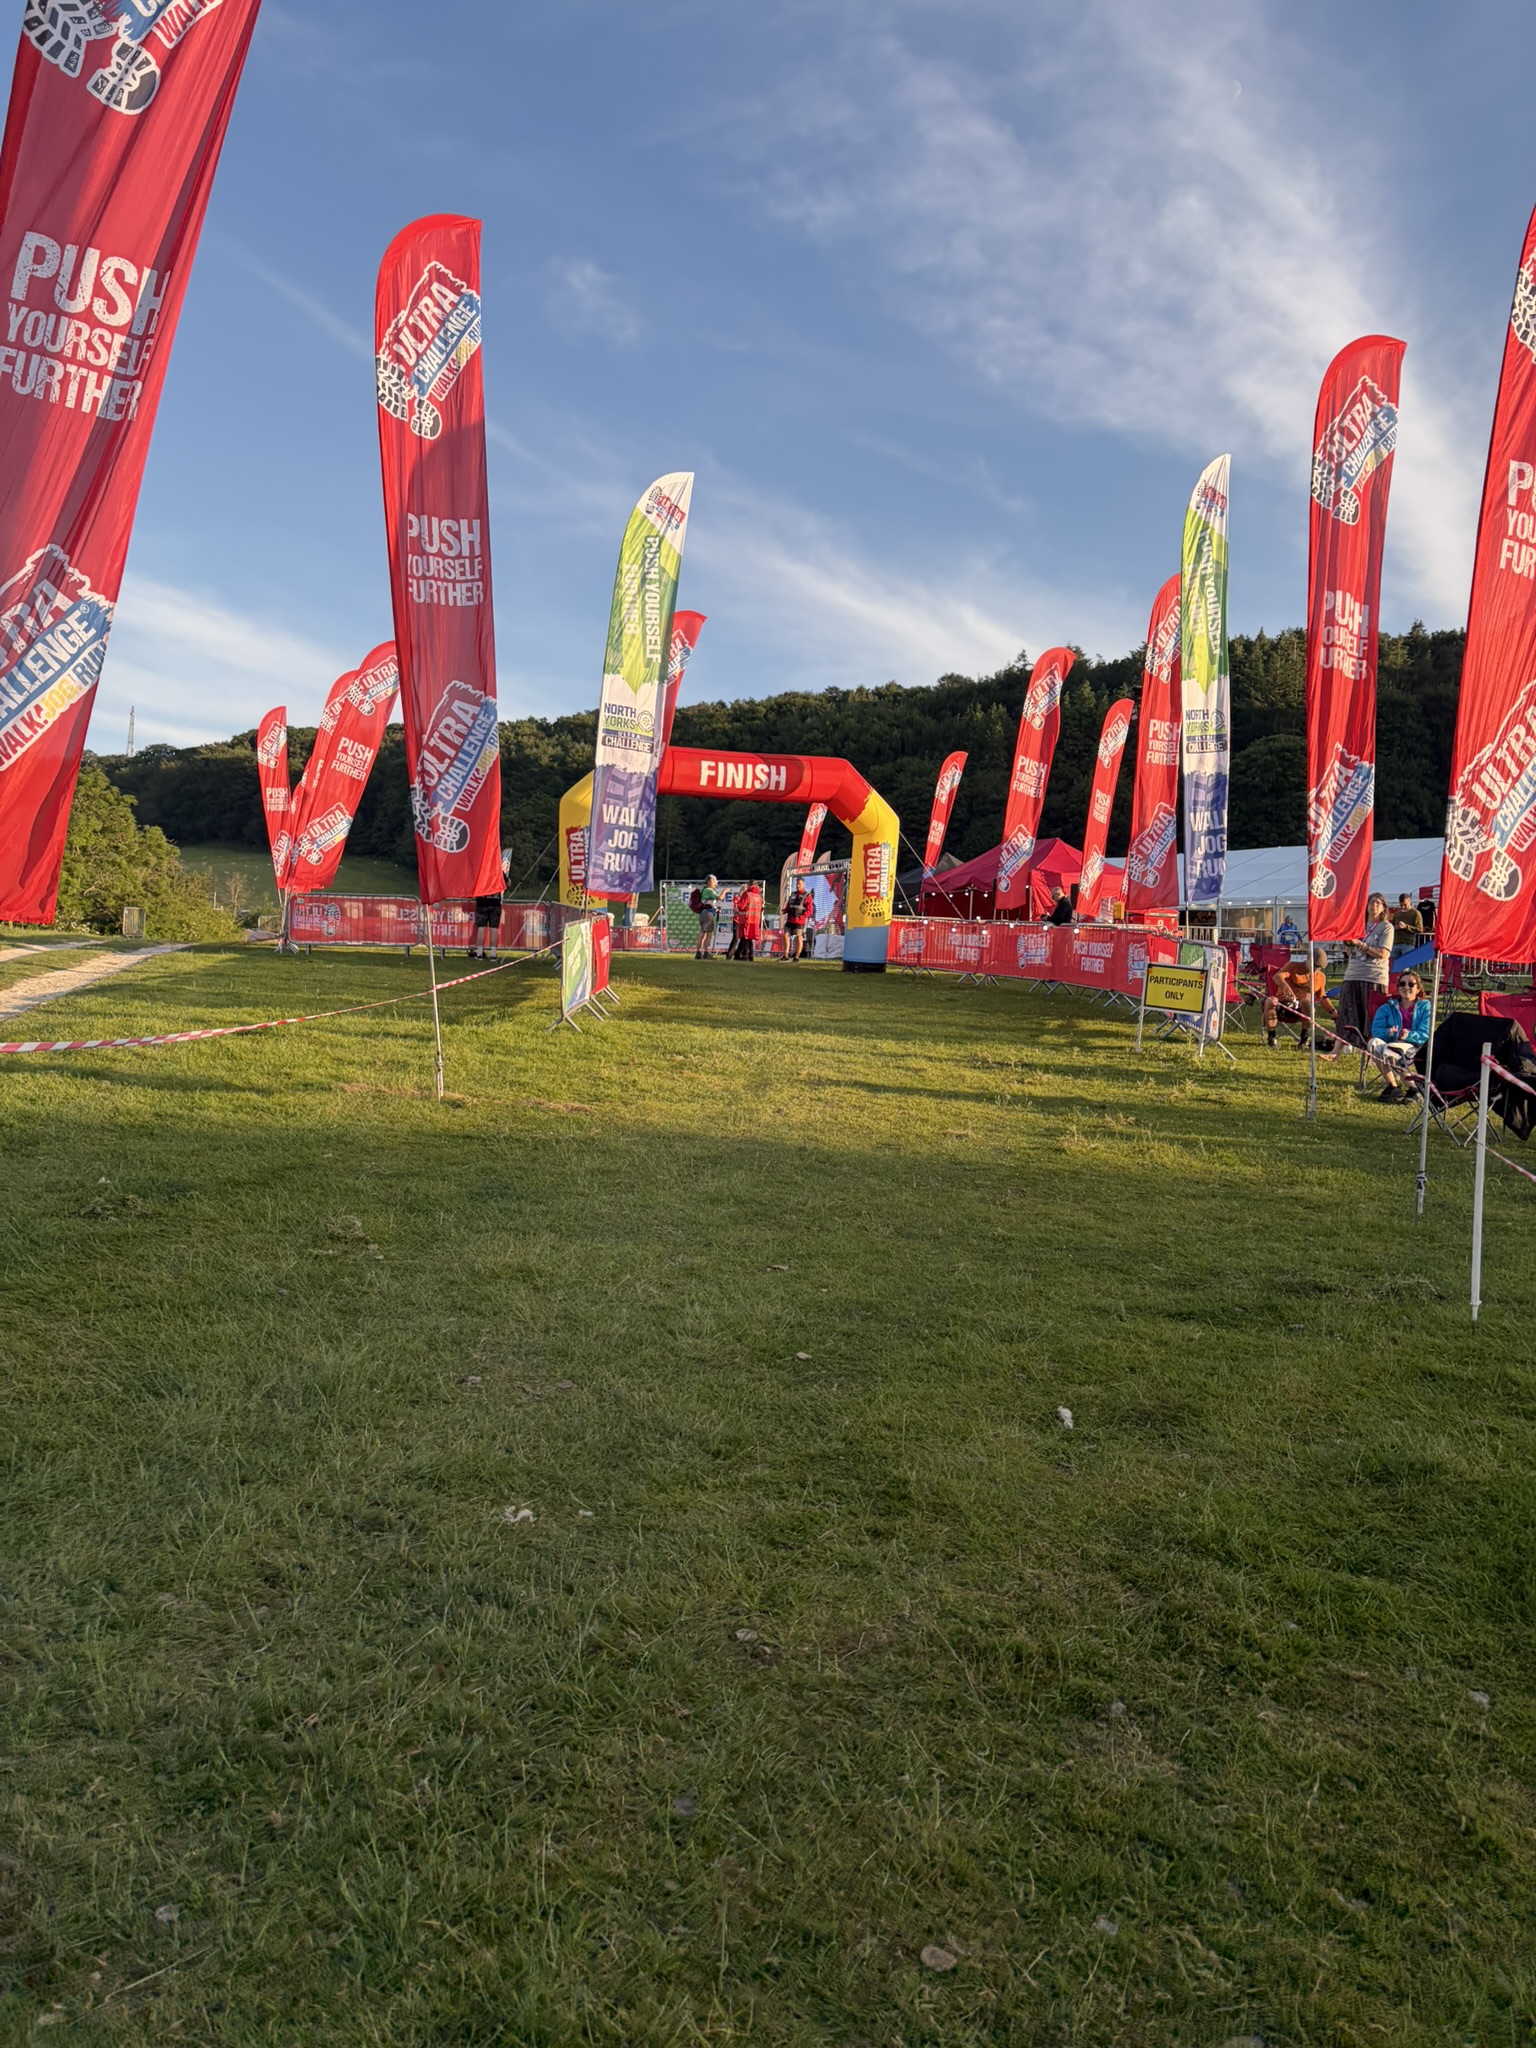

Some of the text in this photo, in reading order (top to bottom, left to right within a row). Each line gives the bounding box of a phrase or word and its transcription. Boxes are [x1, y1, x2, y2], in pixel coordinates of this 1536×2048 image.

[11, 231, 170, 335] PUSH
[392, 281, 460, 366] ULTRA
[6, 302, 153, 378] YOURSELF
[414, 300, 476, 384] CHALLENGE
[0, 345, 143, 421] FURTHER
[407, 512, 480, 557] PUSH
[645, 536, 661, 663] PUSH YOURSELF
[1325, 590, 1369, 637] PUH
[1323, 626, 1368, 657] OURELF
[0, 608, 97, 722] ALLENGE
[363, 661, 398, 689] ULTRA
[603, 714, 636, 730] YORKS
[604, 702, 637, 719] NORTH
[423, 699, 481, 787] ULTRA
[605, 735, 651, 753] CHALLENGE
[1149, 718, 1181, 741] PUSH
[335, 750, 369, 771] YOURSELF
[338, 736, 374, 763] PUSH
[436, 710, 494, 801] CHALLENGE
[330, 759, 366, 782] FURTHER
[700, 760, 786, 791] FINISH
[1017, 755, 1047, 780] PUSH
[1307, 759, 1354, 834] UTRA
[1497, 754, 1536, 832] CHALL
[309, 809, 345, 838] ULTRA
[602, 804, 649, 829] WALK
[570, 830, 585, 880] ULTRA
[607, 829, 638, 851] JOG
[1000, 831, 1028, 864] ULTRA
[1150, 820, 1176, 862] CHALLEN
[1197, 833, 1227, 855] JOG
[603, 851, 637, 873] RUN
[866, 847, 881, 893] ULTRA
[1073, 940, 1088, 955] PUSH
[1081, 956, 1105, 973] FURTHER
[1149, 975, 1203, 989] PARTICIPANTS
[1164, 990, 1184, 1001] ONLY
